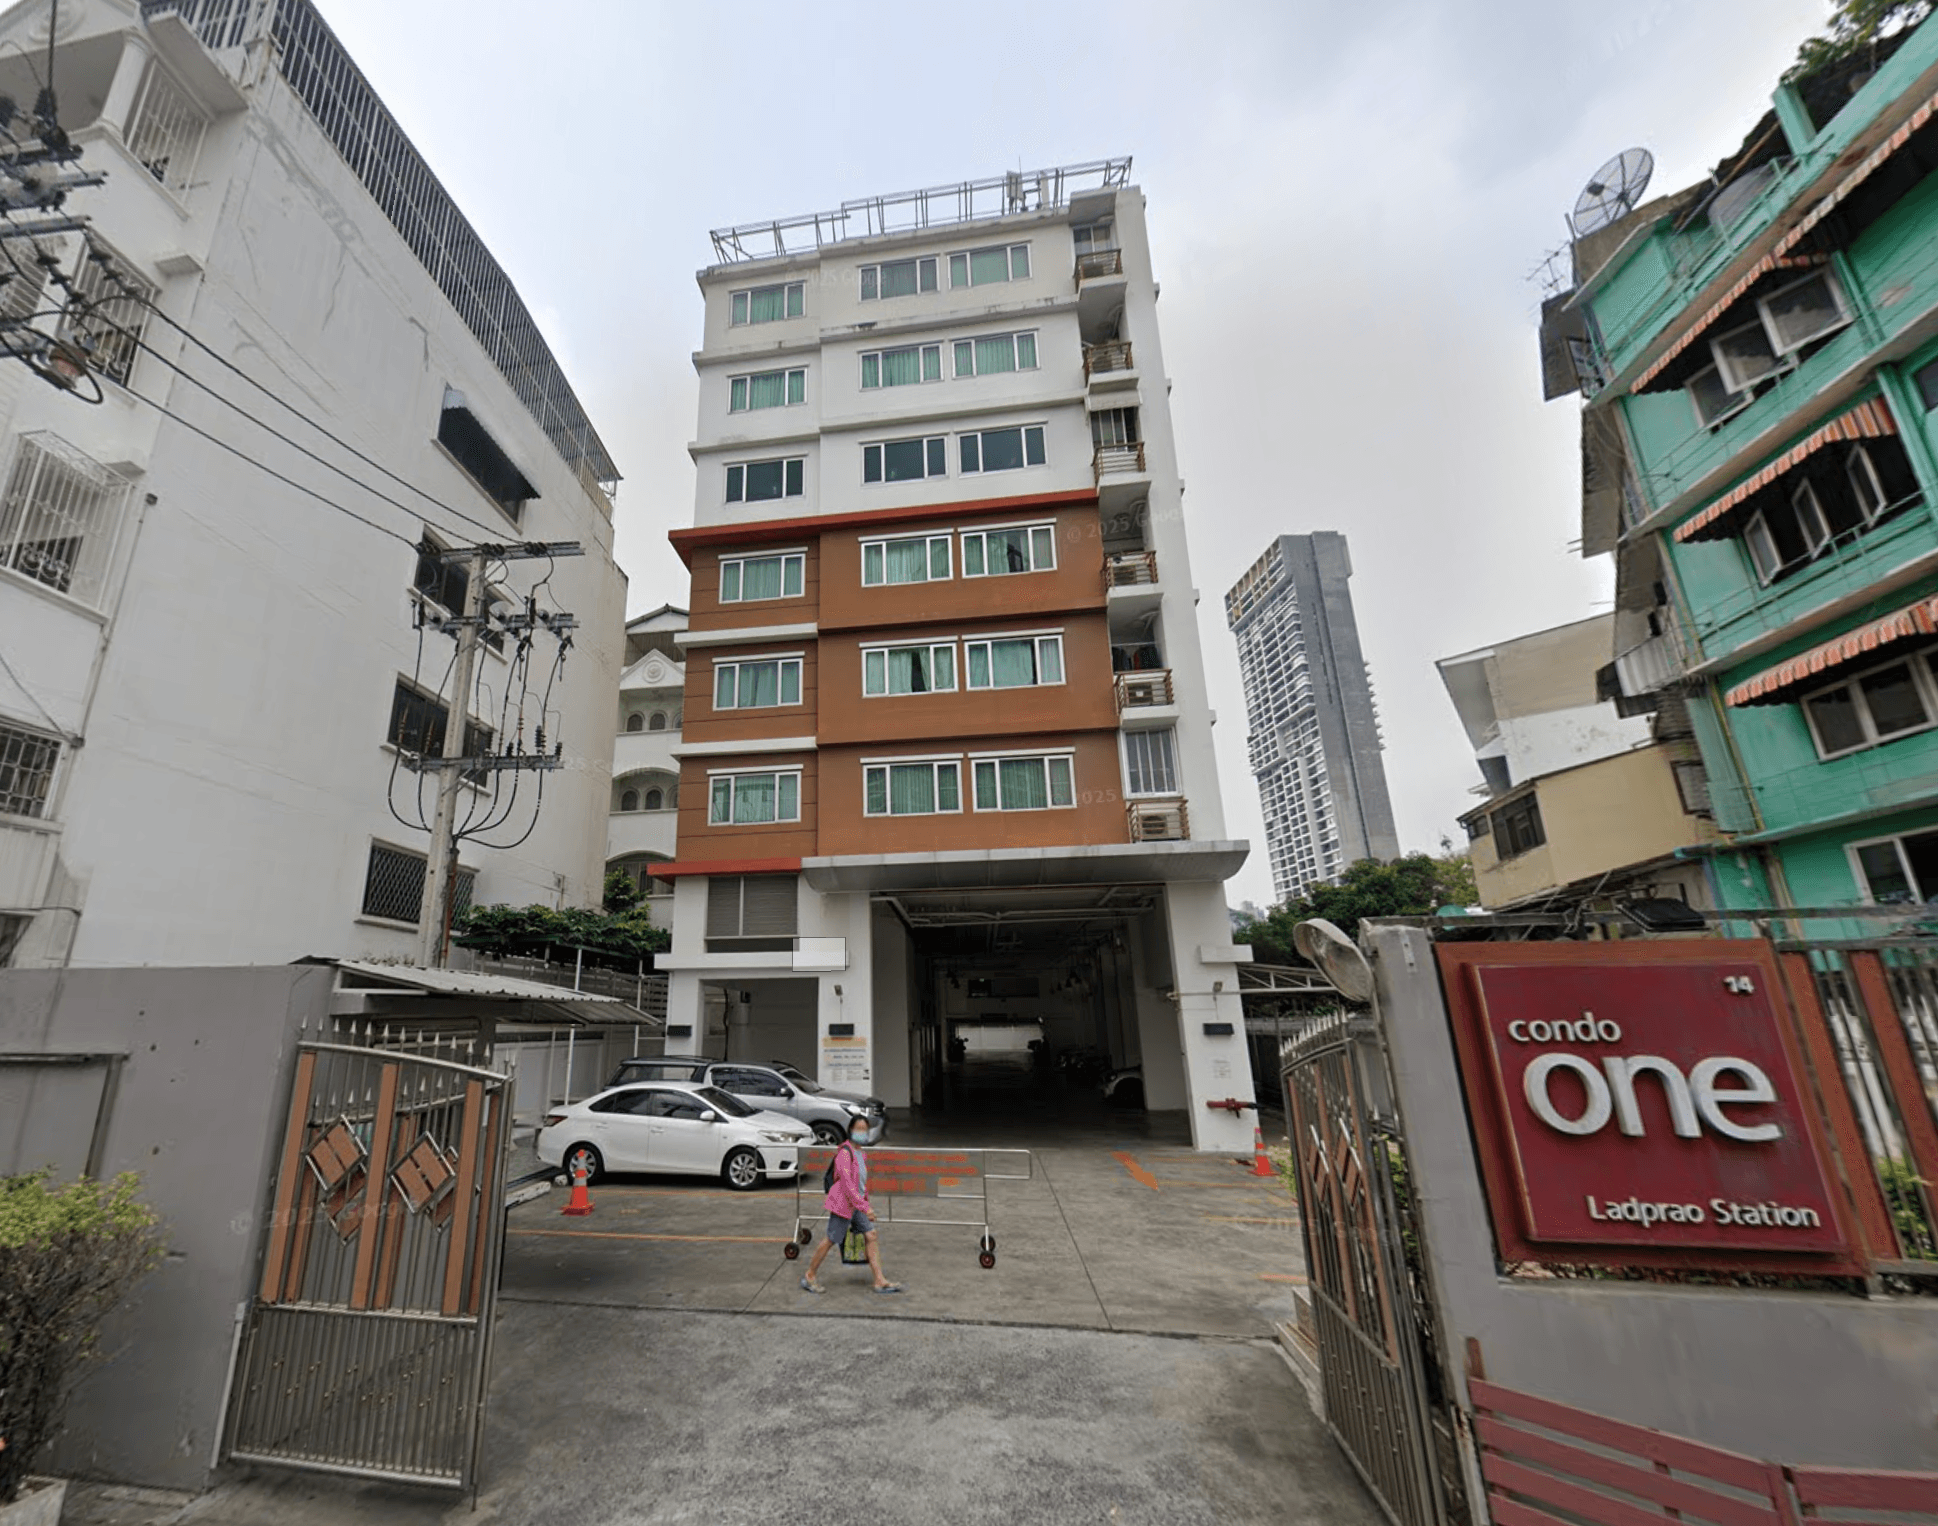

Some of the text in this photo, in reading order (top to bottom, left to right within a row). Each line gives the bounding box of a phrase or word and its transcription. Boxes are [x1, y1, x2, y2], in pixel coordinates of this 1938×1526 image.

[1508, 1010, 1622, 1043] condo
[1523, 1052, 1784, 1141] one
[1587, 1194, 1822, 1228] Ladprao Station
